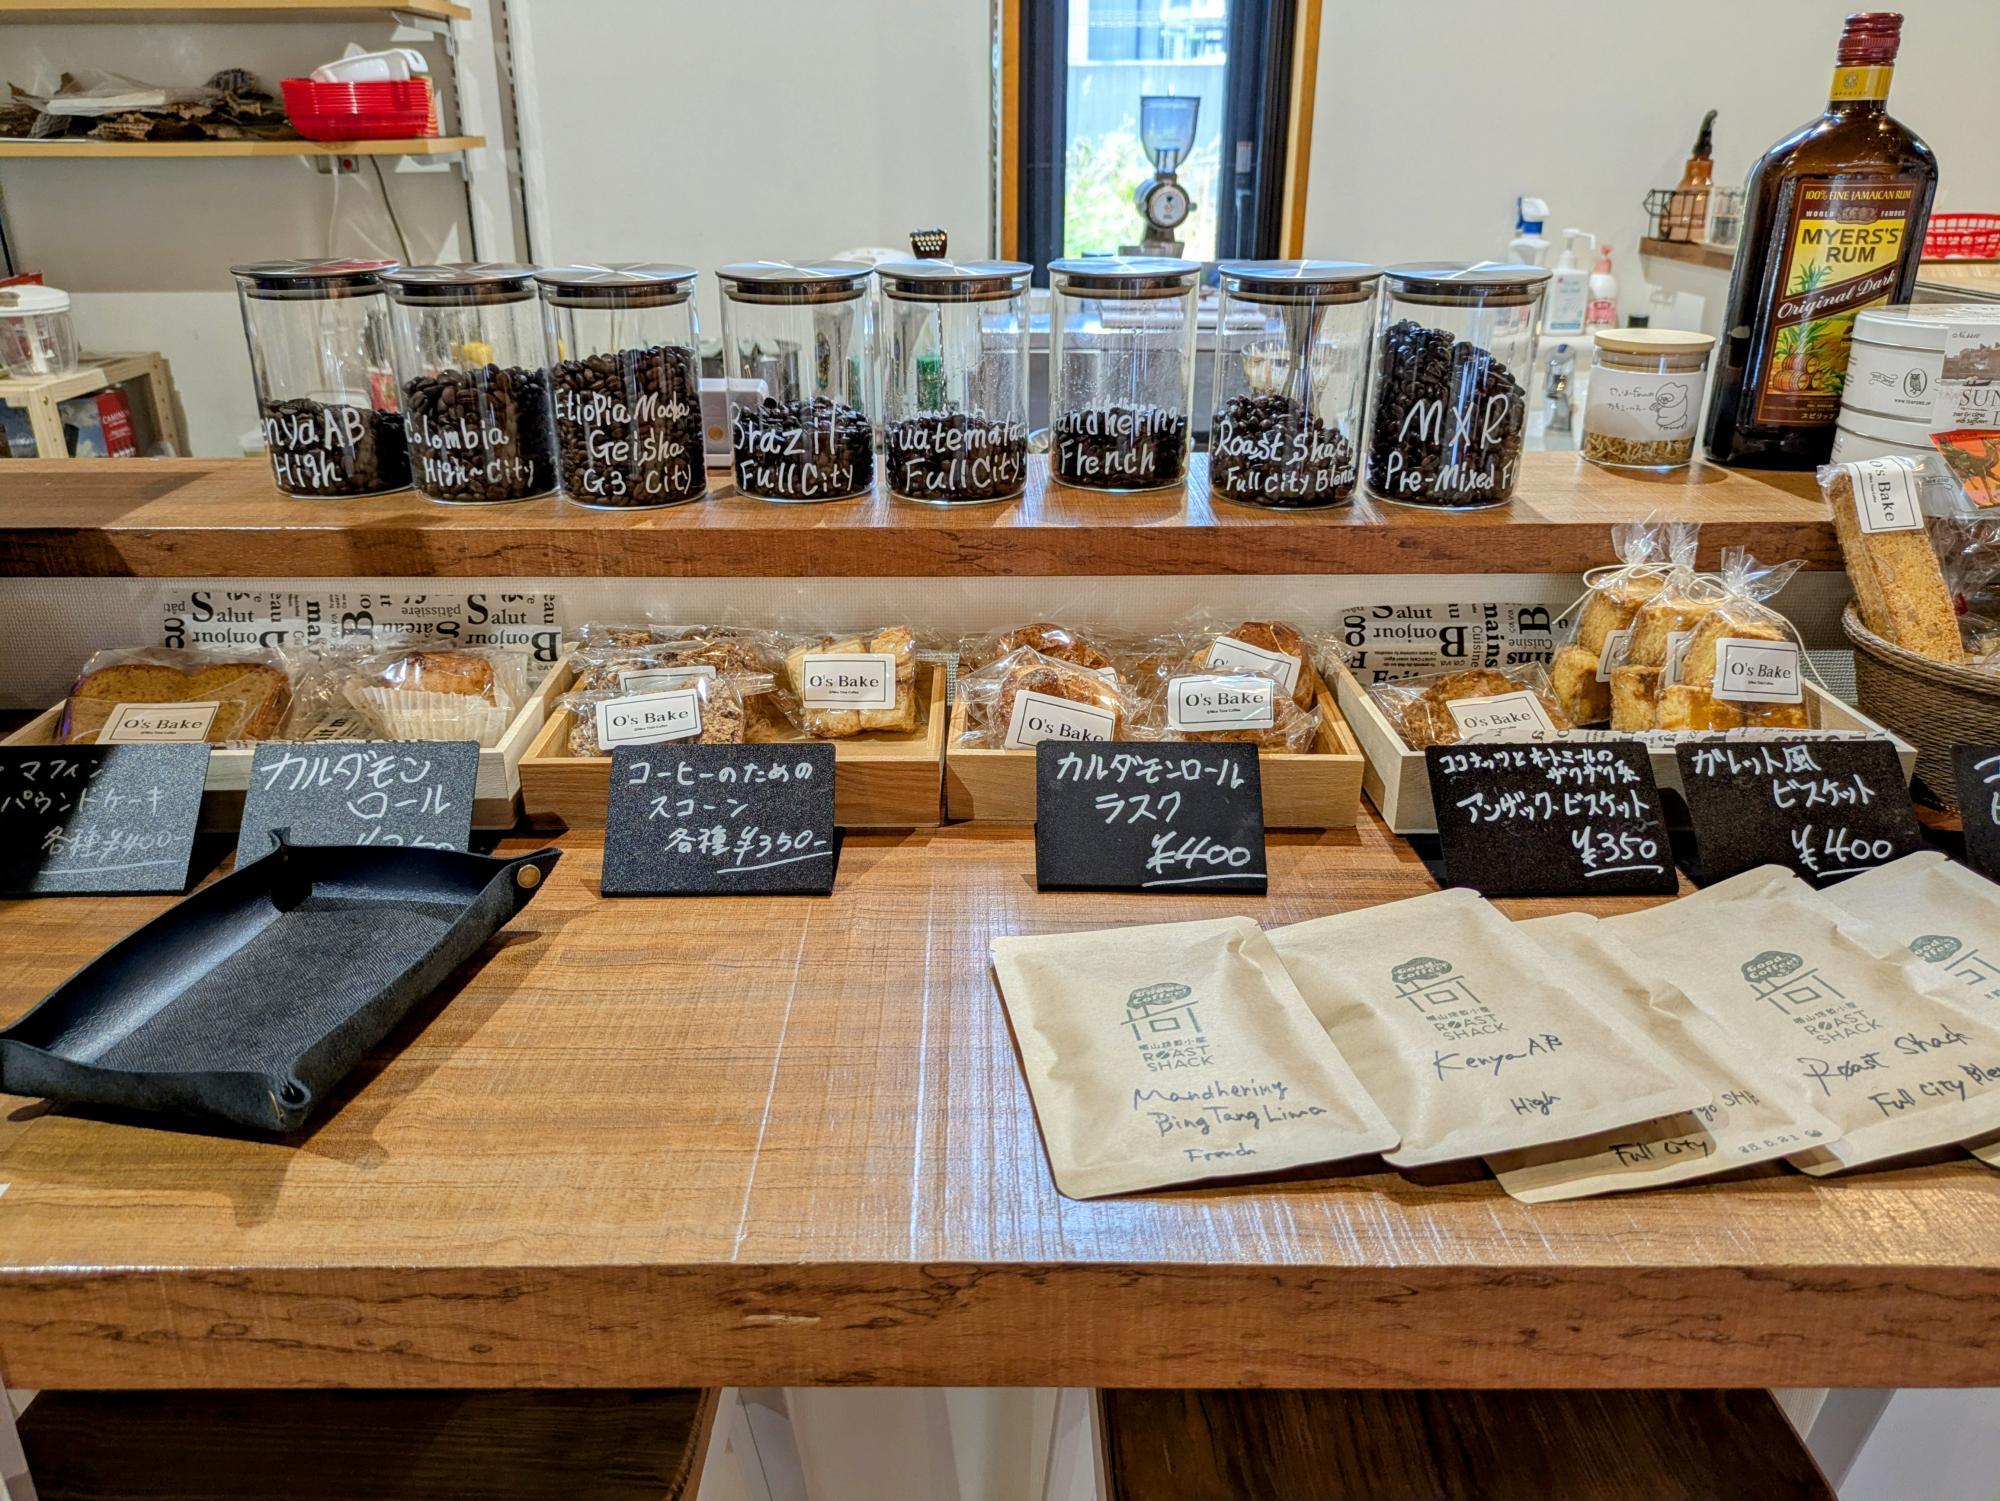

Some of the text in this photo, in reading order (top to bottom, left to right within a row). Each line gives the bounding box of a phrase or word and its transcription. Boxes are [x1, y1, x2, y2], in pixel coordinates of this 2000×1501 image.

[1805, 189, 1912, 201] 100% FINE JAMAICAN RUM
[1801, 228, 1899, 245] MYERS'S
[1825, 247, 1876, 263] RUM
[1776, 271, 1896, 319] Original Dark
[322, 407, 366, 450] AB
[404, 411, 509, 450] Colombia
[730, 399, 837, 456] Brazil
[888, 410, 1022, 453] uatemala
[1215, 419, 1284, 462] Roast
[589, 427, 685, 466] Geisha
[1060, 439, 1156, 476] French
[272, 451, 343, 489] High
[583, 463, 692, 496] G3 City
[1385, 450, 1495, 492] Pre-Mixed
[1878, 481, 1896, 523] Bake
[191, 591, 255, 623] Salut
[401, 603, 461, 618] pâtissière
[467, 594, 527, 625] Salut
[465, 629, 561, 662] Bonjour
[1373, 623, 1469, 657] Bonjour
[1470, 625, 1483, 668] Cuisine
[1508, 638, 1553, 650] Cuisine
[809, 674, 880, 687] O's Bake
[1731, 662, 1792, 679] O's Bake
[1185, 692, 1264, 706] O's Bake
[123, 718, 203, 729] O's Bake
[613, 710, 689, 727] O's Bake
[1028, 717, 1104, 742] O's Bake
[1463, 712, 1532, 729] O's Bake
[260, 750, 431, 790] カルダモン
[628, 761, 813, 786] コーヒーのための
[1056, 751, 1245, 789] カルダモンロール
[1692, 745, 1822, 777] ガレット風
[1, 786, 163, 817] パウンドケーキ
[346, 784, 451, 820] ロール
[648, 795, 749, 820] スコーン
[1095, 790, 1181, 824] ラスク
[1773, 774, 1875, 809] ビスケット
[1145, 830, 1252, 874] ¥400
[1571, 825, 1658, 868] ¥350
[1791, 825, 1893, 871] ¥400
[1442, 1022, 1511, 1041] SHACK
[1816, 1018, 1884, 1045] SHACK
[1893, 1023, 1975, 1055] Shack
[1146, 1054, 1215, 1072] SHACK
[1433, 1050, 1528, 1082] Kenya
[1510, 1090, 1562, 1116] High
[1919, 1077, 1965, 1102] City
[1147, 1111, 1211, 1137] Bing
[1202, 1105, 1260, 1130] Tang
[1609, 1138, 1708, 1167] Full City
